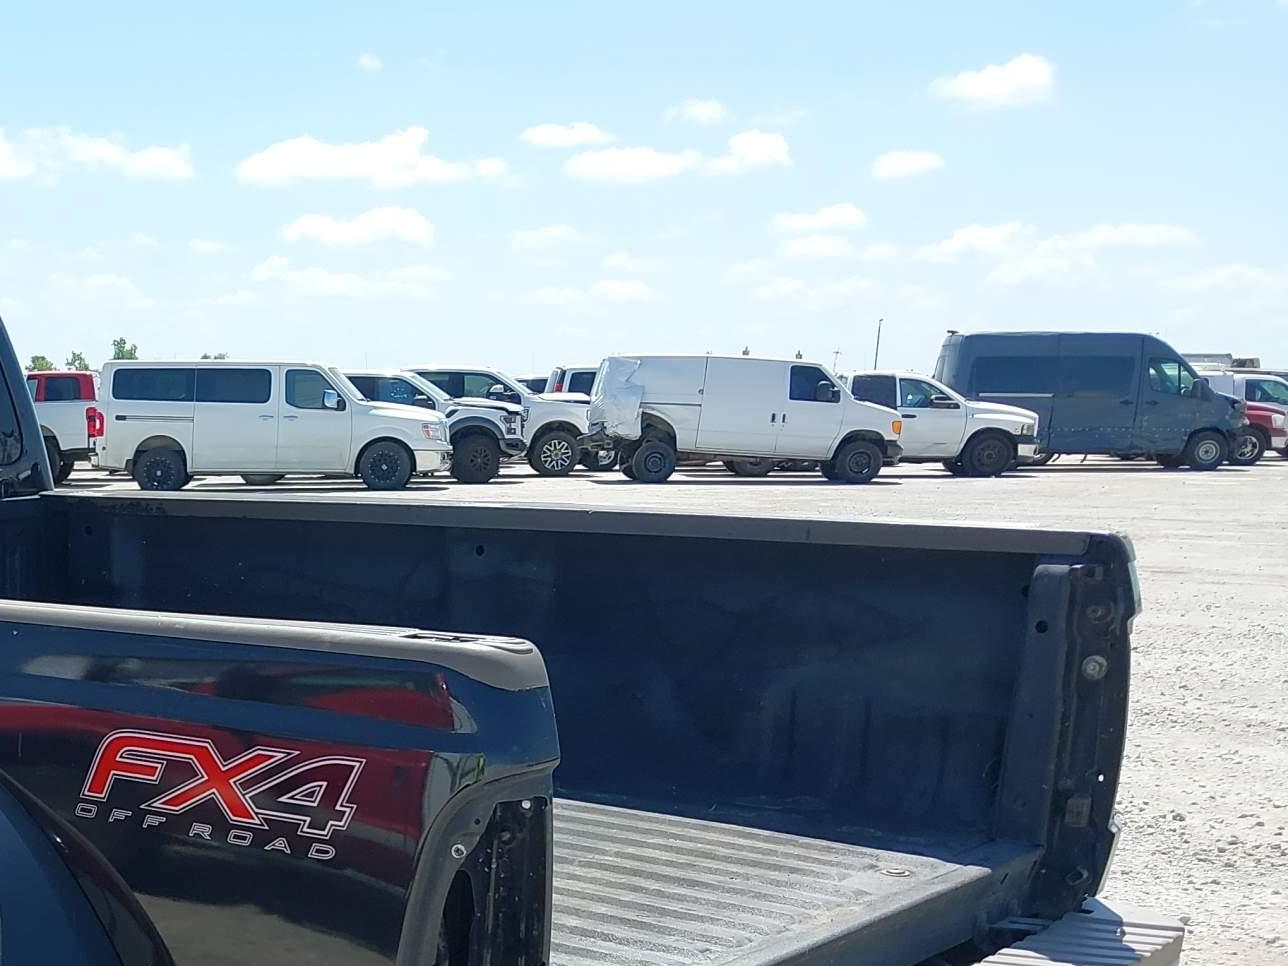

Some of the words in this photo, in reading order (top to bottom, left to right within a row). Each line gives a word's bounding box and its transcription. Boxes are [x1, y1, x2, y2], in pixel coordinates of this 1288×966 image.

[79, 729, 366, 840] FX4
[74, 803, 167, 829] OFF
[187, 822, 336, 861] ROAD
